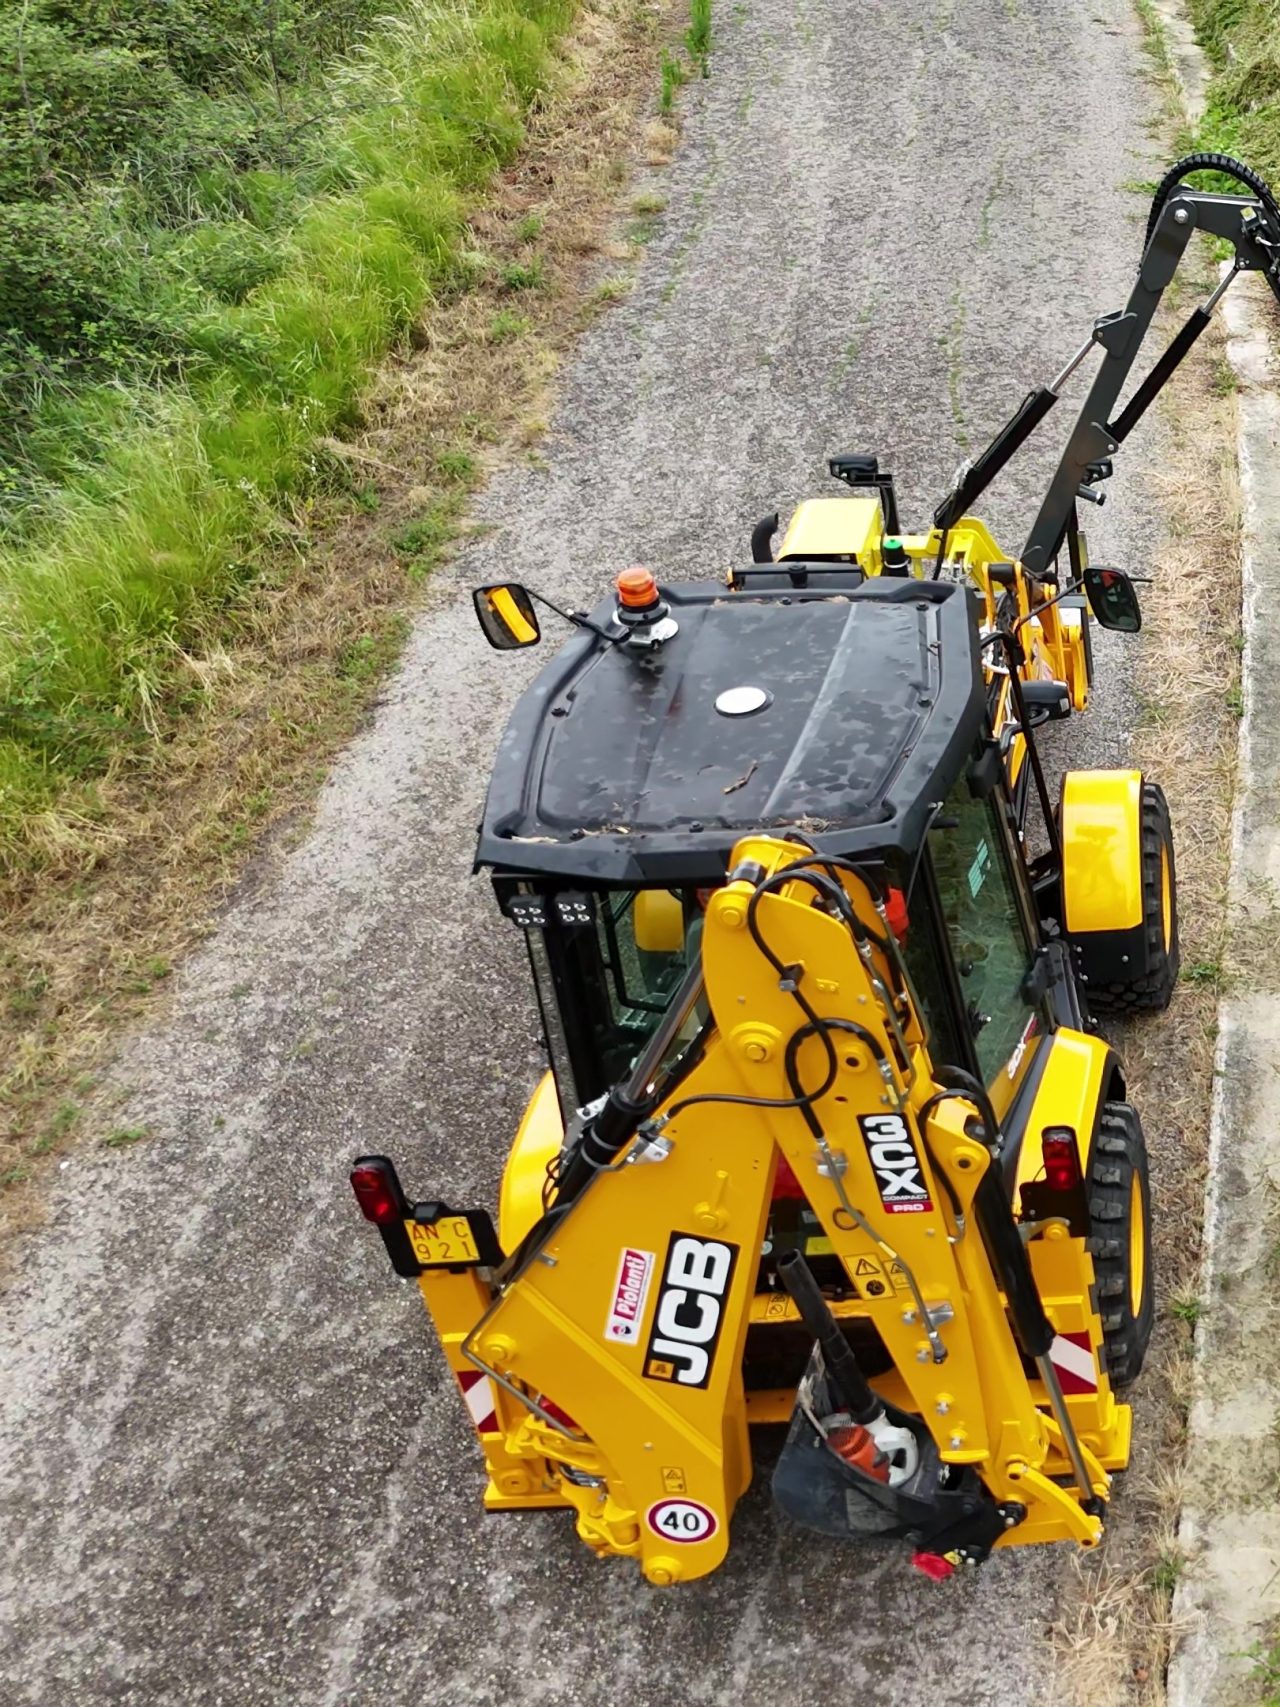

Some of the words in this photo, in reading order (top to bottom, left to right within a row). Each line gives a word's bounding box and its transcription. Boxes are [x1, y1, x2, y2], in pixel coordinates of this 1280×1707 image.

[863, 1115, 928, 1196] 3CX
[882, 1193, 929, 1202] COMPACT
[892, 1203, 925, 1212] PRO
[412, 1223, 440, 1241] AN
[615, 1253, 647, 1317] Piolanti
[652, 1237, 732, 1385] JCB
[662, 1510, 701, 1532] 40
